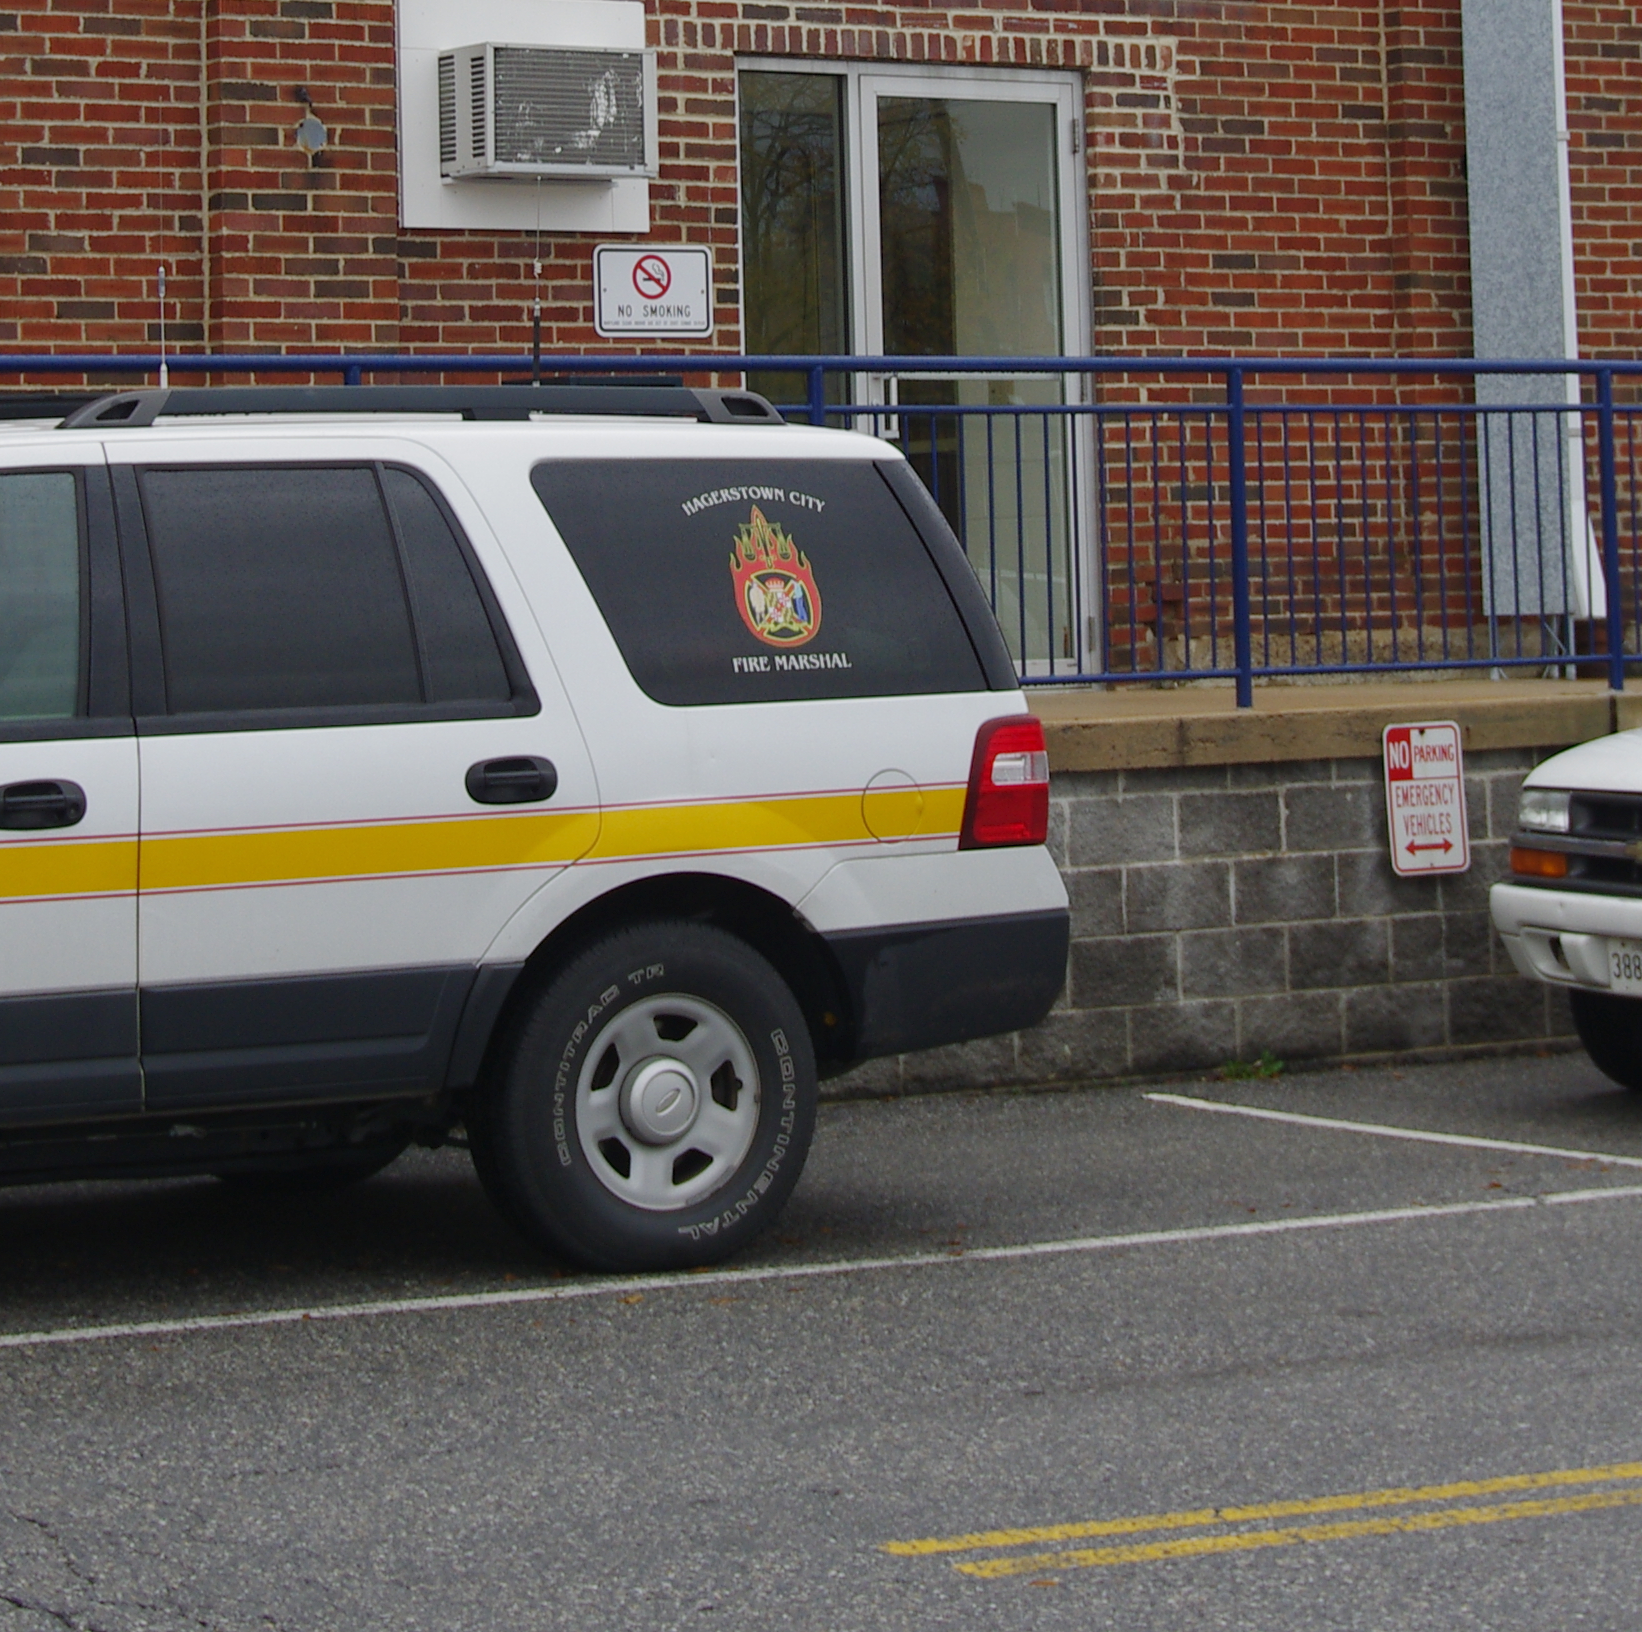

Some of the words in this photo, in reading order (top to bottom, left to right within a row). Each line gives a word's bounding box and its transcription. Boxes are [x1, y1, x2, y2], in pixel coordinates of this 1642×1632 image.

[618, 305, 632, 317] NO
[643, 305, 691, 317] SMOKING
[681, 486, 785, 516] HAGERSTOWN
[789, 491, 825, 512] CITY
[732, 656, 771, 673] FIRE
[774, 653, 852, 671] MARSHAL
[1389, 740, 1409, 769] NO
[1414, 744, 1455, 762] PARKING
[1395, 784, 1454, 808] EMERGENCY
[1403, 813, 1452, 836] VEHICLES
